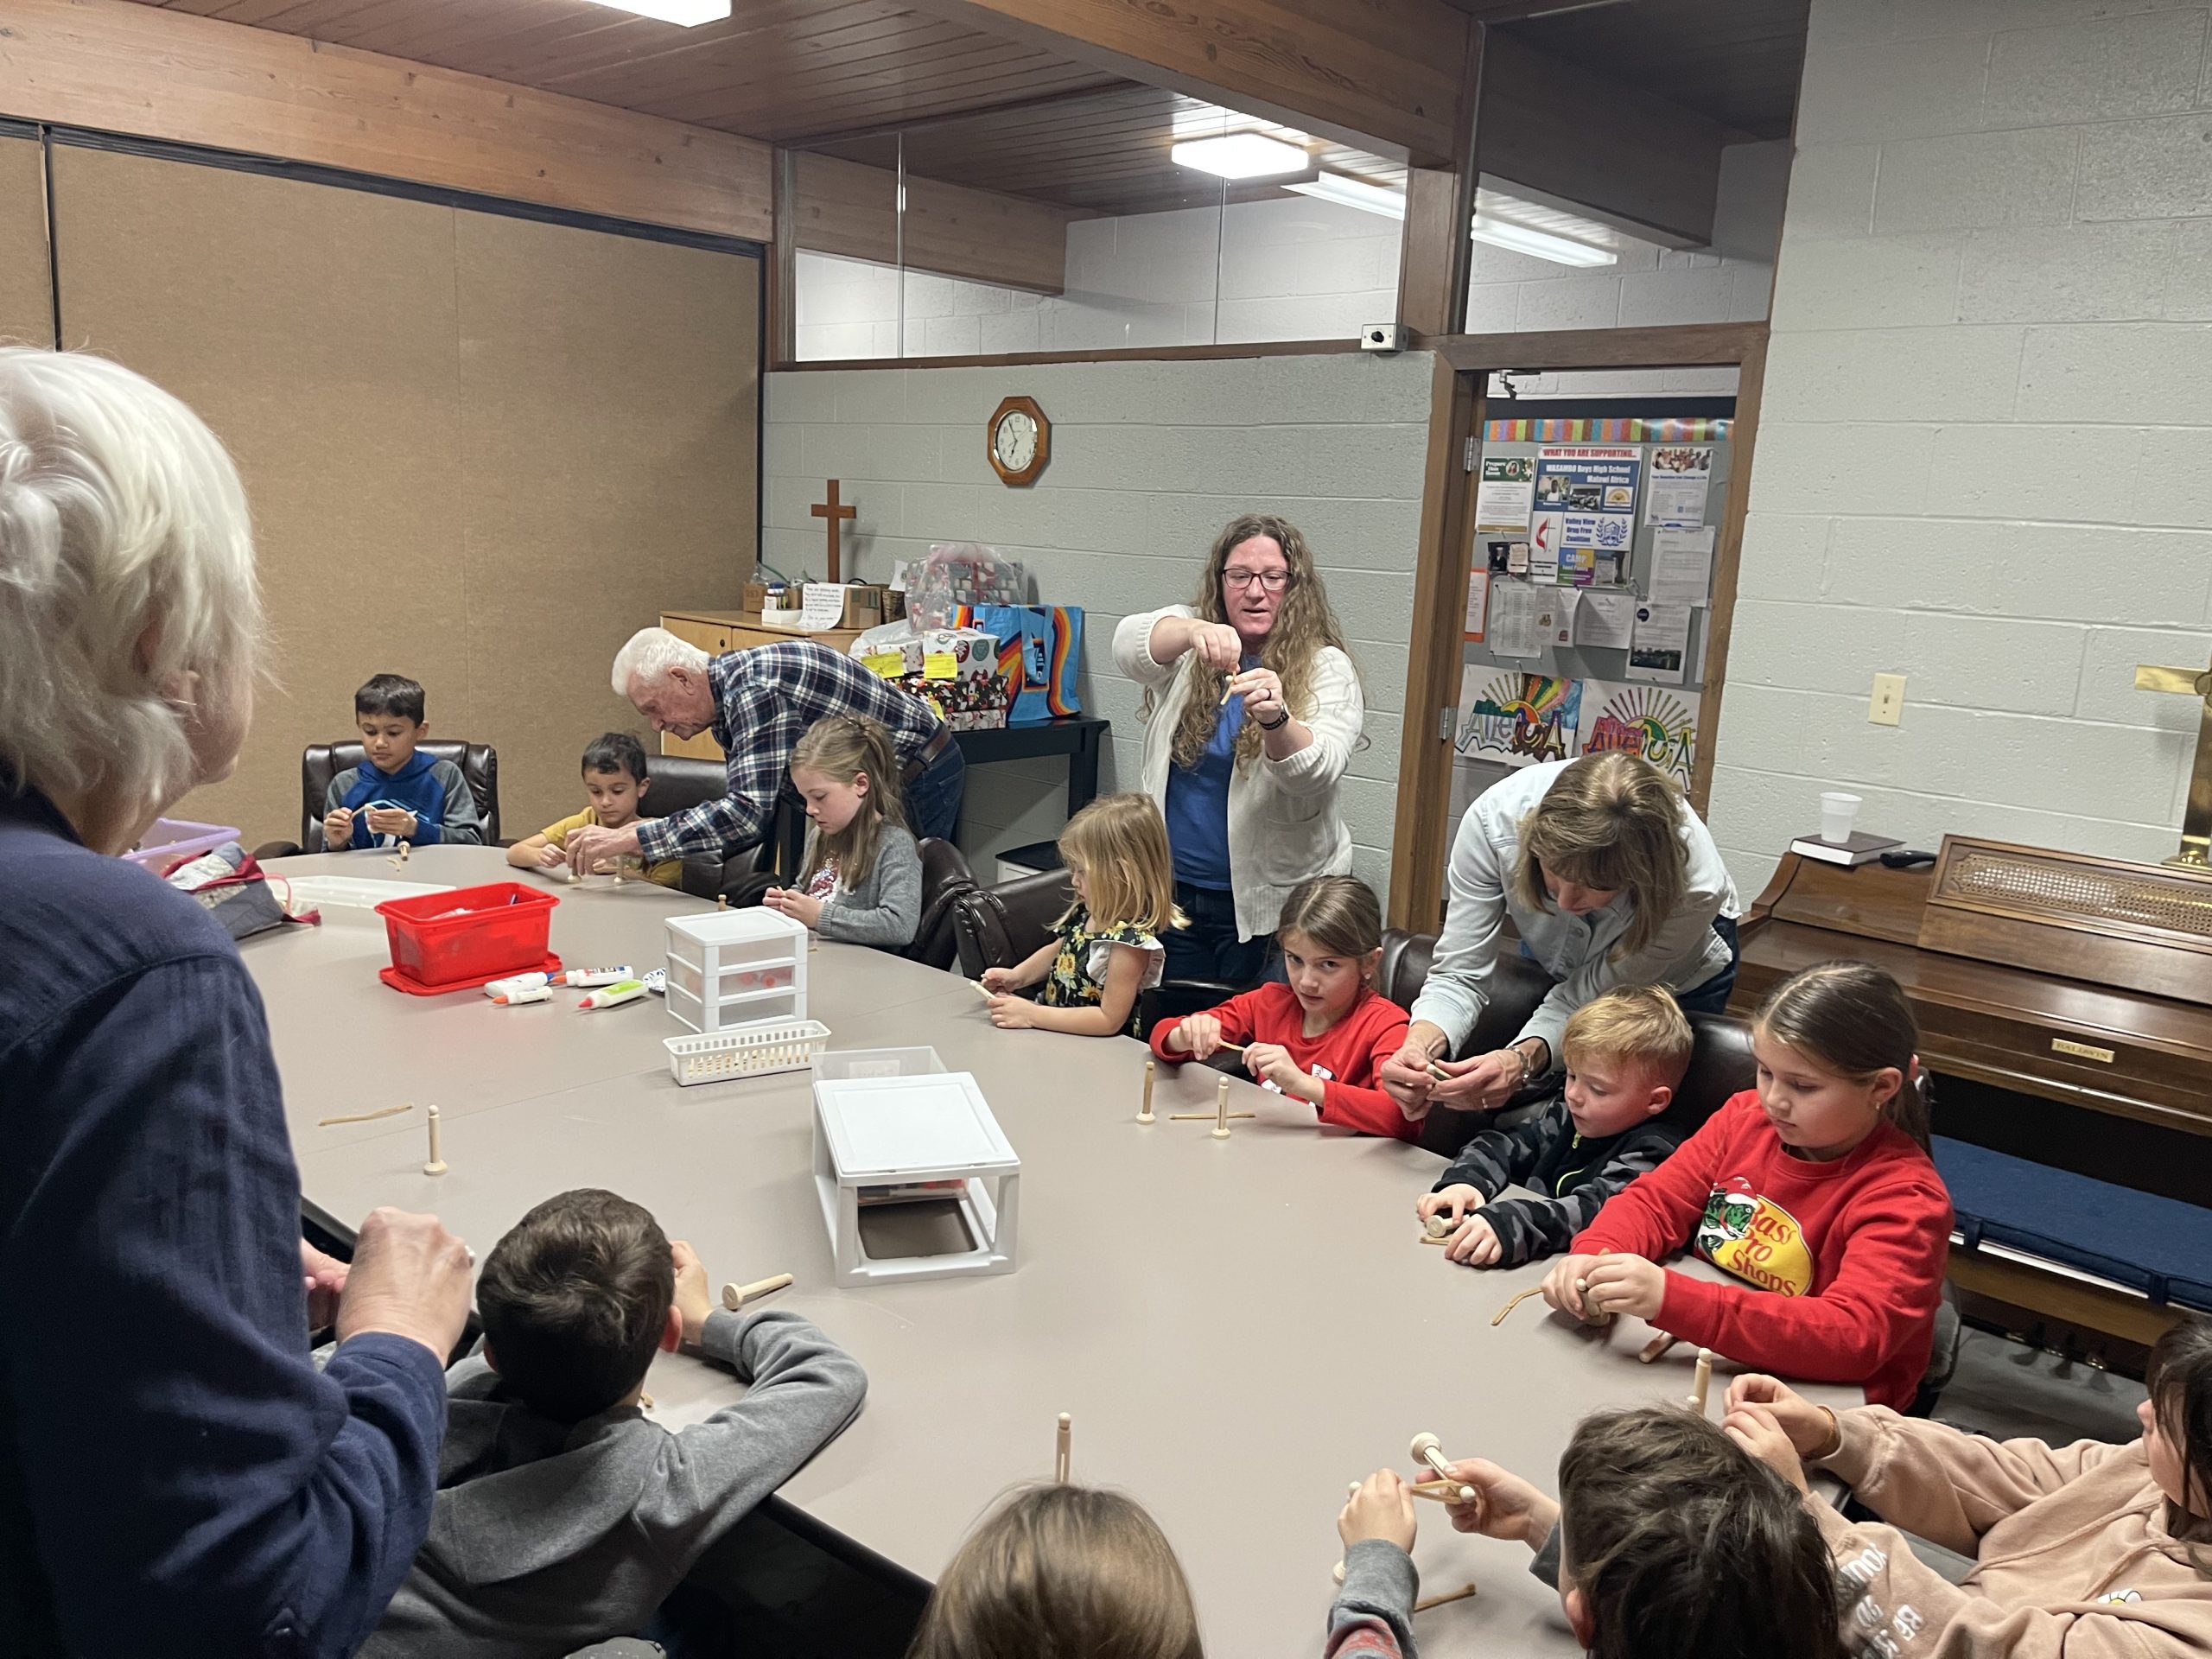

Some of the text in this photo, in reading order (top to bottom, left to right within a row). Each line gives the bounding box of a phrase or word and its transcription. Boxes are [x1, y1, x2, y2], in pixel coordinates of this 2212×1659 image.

[1542, 448, 1562, 457] WHAT
[1563, 448, 1576, 457] YOU
[1577, 448, 1589, 457] ARE
[1592, 465, 1607, 474] High
[1608, 465, 1631, 474] School
[1610, 475, 1630, 484] Africa
[1726, 1249, 1796, 1298] Shops
